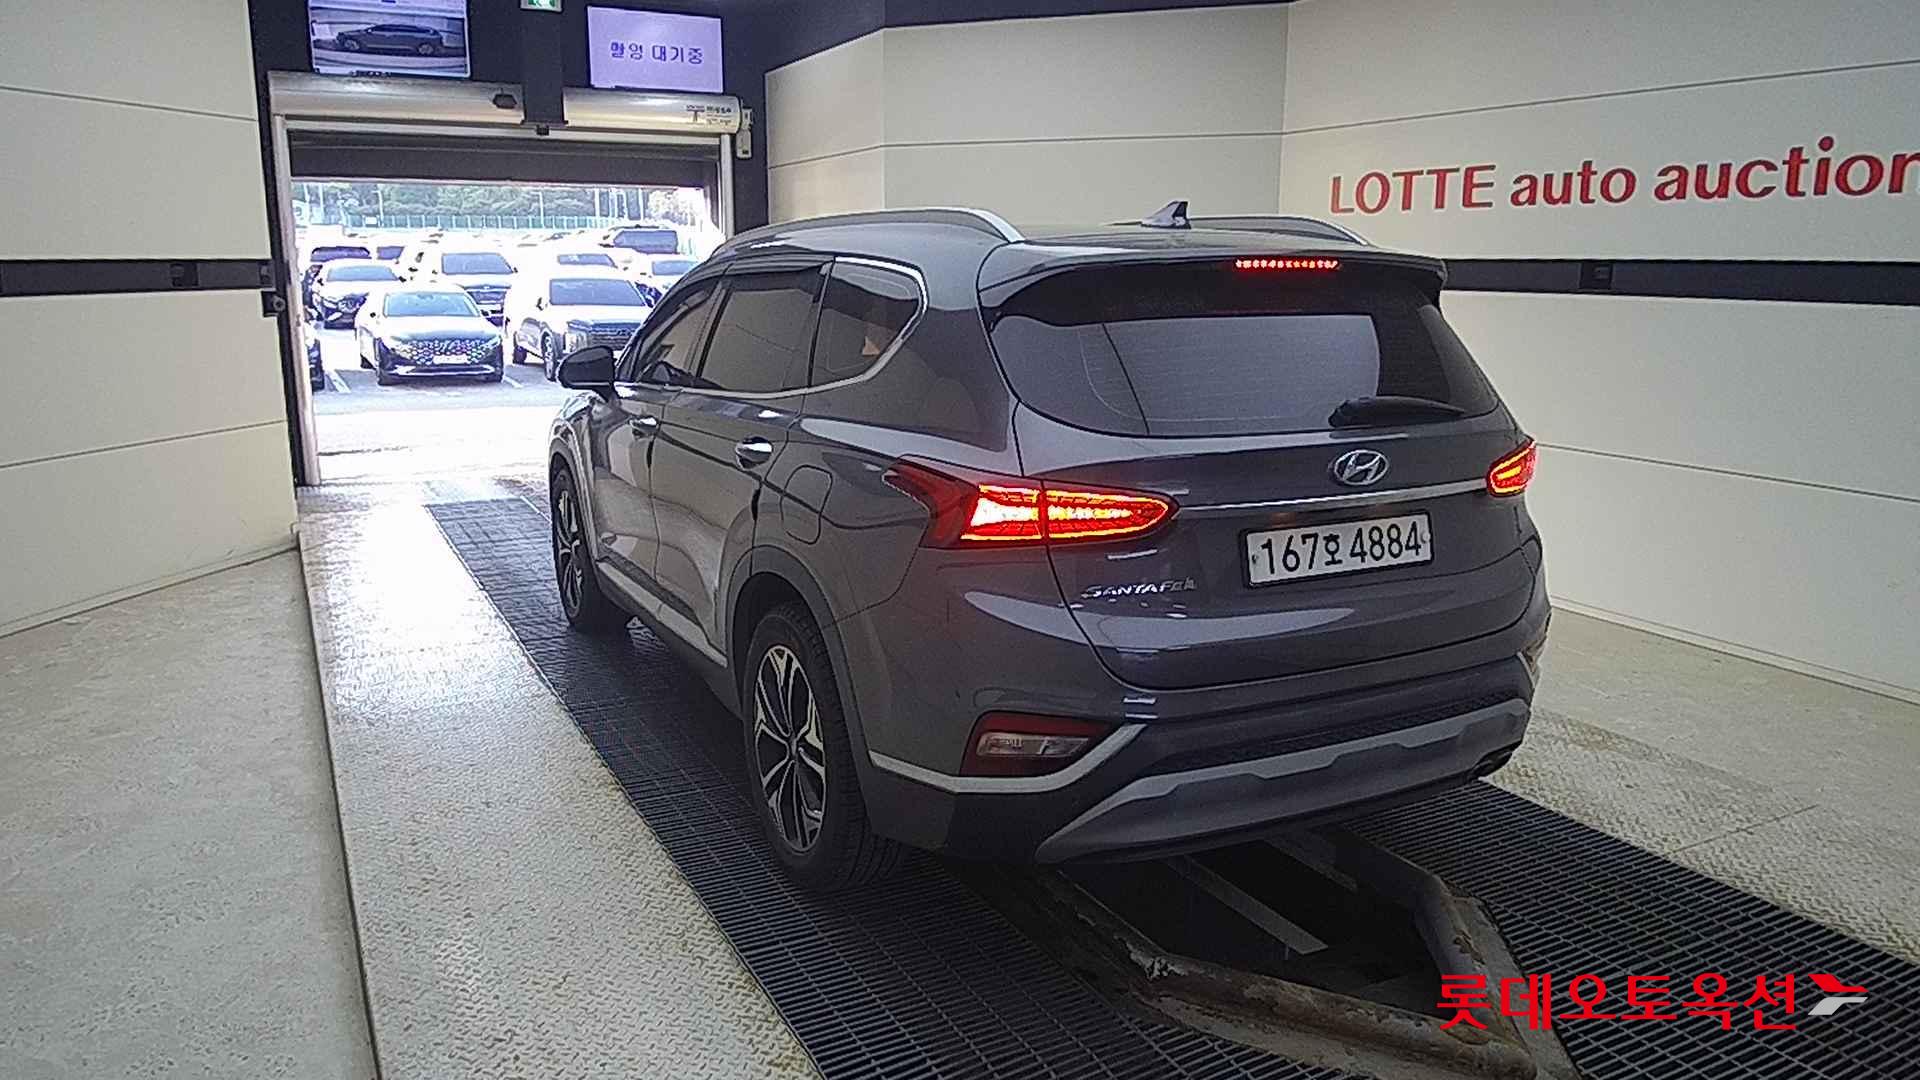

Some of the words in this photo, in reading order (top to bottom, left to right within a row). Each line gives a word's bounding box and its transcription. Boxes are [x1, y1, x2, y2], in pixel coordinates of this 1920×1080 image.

[651, 44, 703, 65] 대기중
[1330, 163, 1498, 215] LOTTE
[1510, 160, 1638, 208] auto
[1653, 136, 1920, 202] auction
